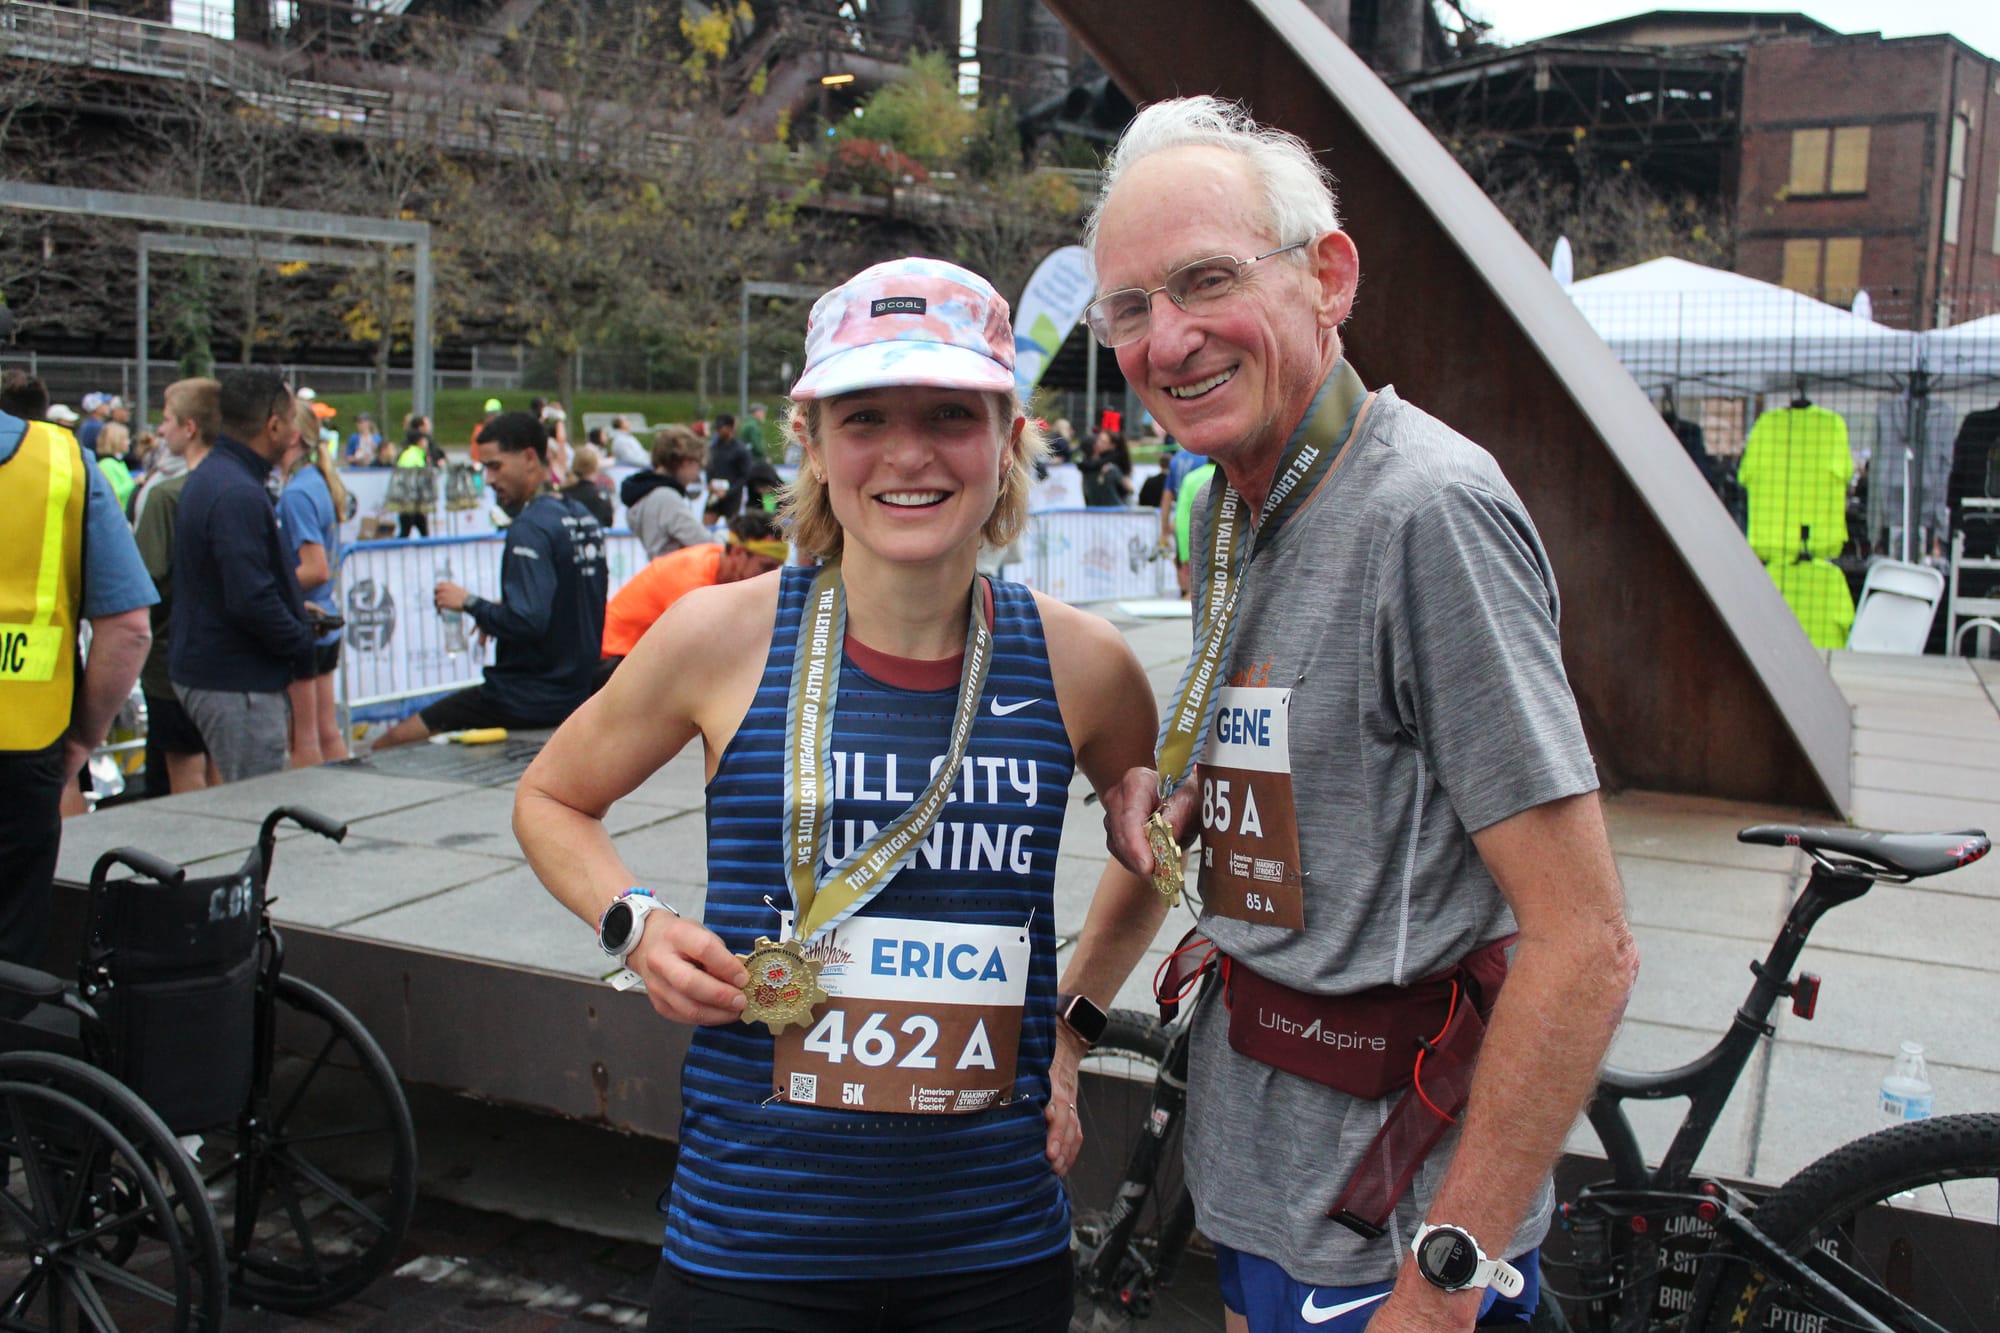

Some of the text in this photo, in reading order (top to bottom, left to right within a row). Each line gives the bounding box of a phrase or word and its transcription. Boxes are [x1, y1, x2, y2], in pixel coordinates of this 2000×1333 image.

[1220, 480, 1240, 520] HIGH
[1265, 443, 1320, 512] THE LEHIGH
[1215, 522, 1234, 570] VALLEY
[0, 632, 28, 673] IC
[1206, 612, 1228, 660] VALLEY
[1187, 659, 1214, 710] LEHIGH
[797, 587, 835, 867] THE LEHIGH VALLEY ORTHOPEDIC INSTITUTE 5K
[1177, 703, 1198, 734] THE
[1216, 707, 1272, 747] GENE
[832, 751, 914, 801] ILL
[845, 625, 988, 891] THE LEHIGH VALLEY ORTHOPEDIC INSTITUTE 5K
[1202, 777, 1264, 838] 85 A
[824, 818, 1034, 875] UNING
[1246, 892, 1275, 913] 85 A
[768, 968, 786, 980] 5K
[870, 937, 1008, 982] ERICA
[803, 1010, 996, 1070] 462 A
[842, 1082, 865, 1106] 5K
[918, 1087, 955, 1096] American
[918, 1095, 946, 1104] Cancer
[918, 1103, 947, 1113] Society
